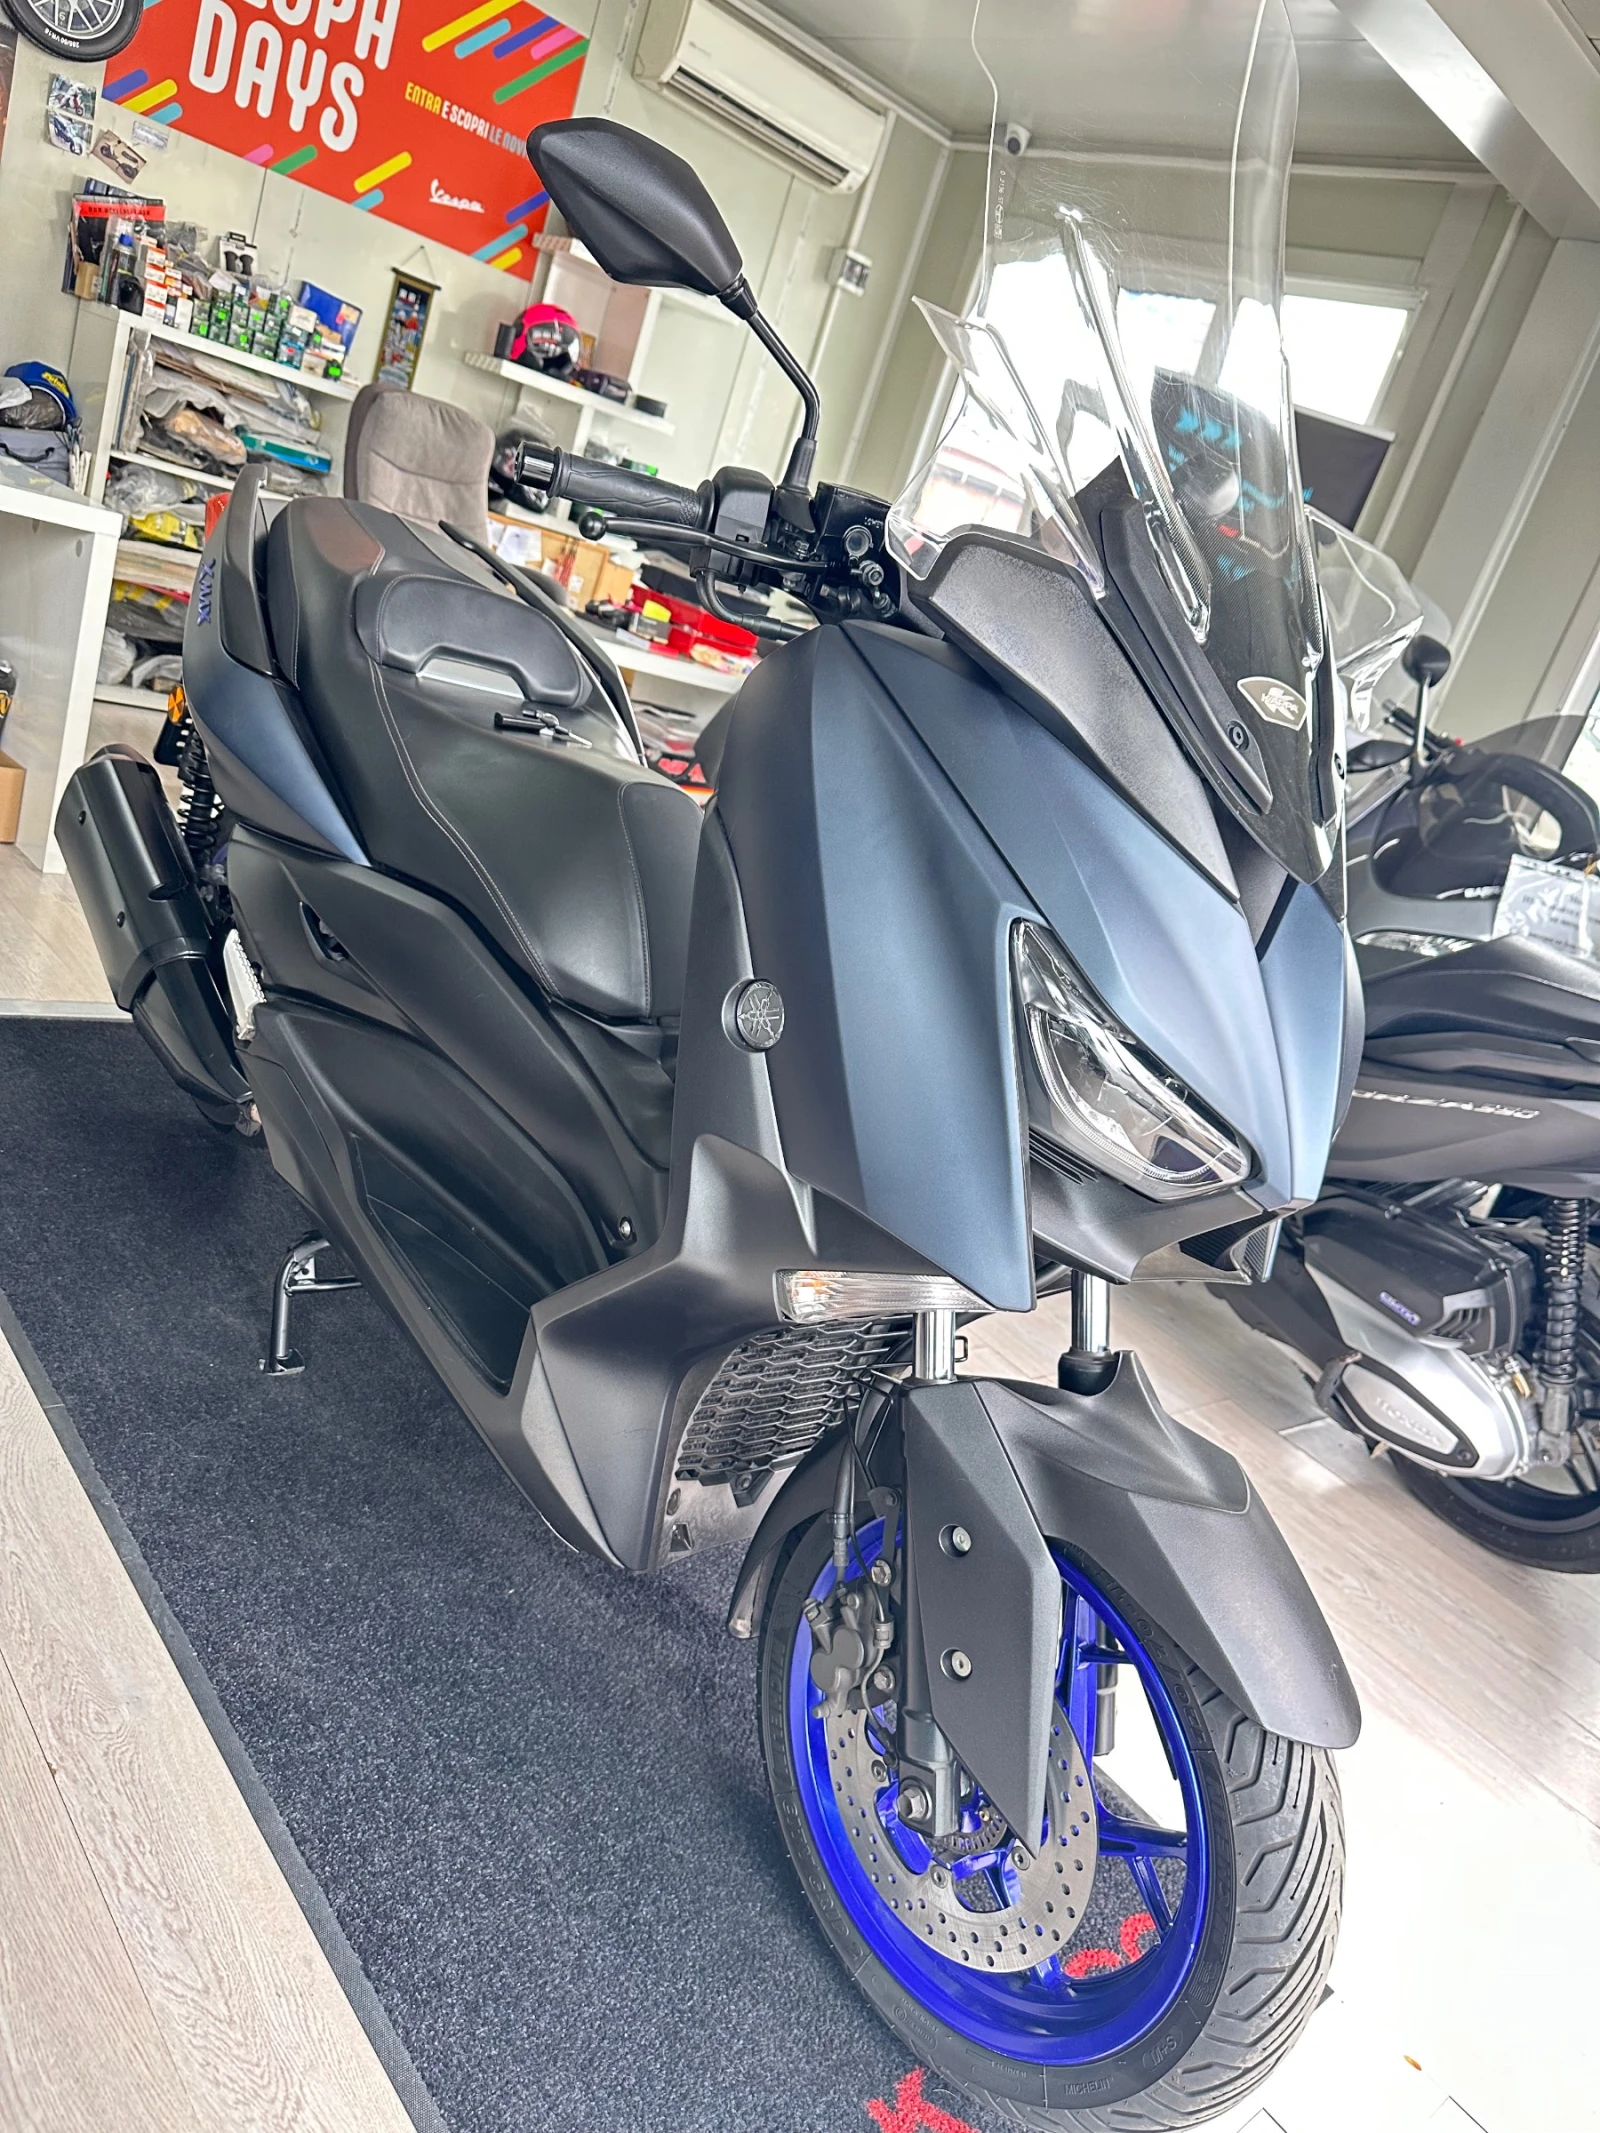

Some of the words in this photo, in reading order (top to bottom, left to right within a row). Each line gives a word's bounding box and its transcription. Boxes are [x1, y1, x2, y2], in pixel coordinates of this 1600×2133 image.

[188, 0, 365, 152] DAYS
[405, 81, 442, 115] ENTRA
[449, 104, 490, 139] SCOPRI
[488, 125, 503, 146] LE
[429, 178, 485, 214] Vespa
[197, 557, 216, 626] XMAX
[1064, 2077, 1111, 2095] MICHELIN
